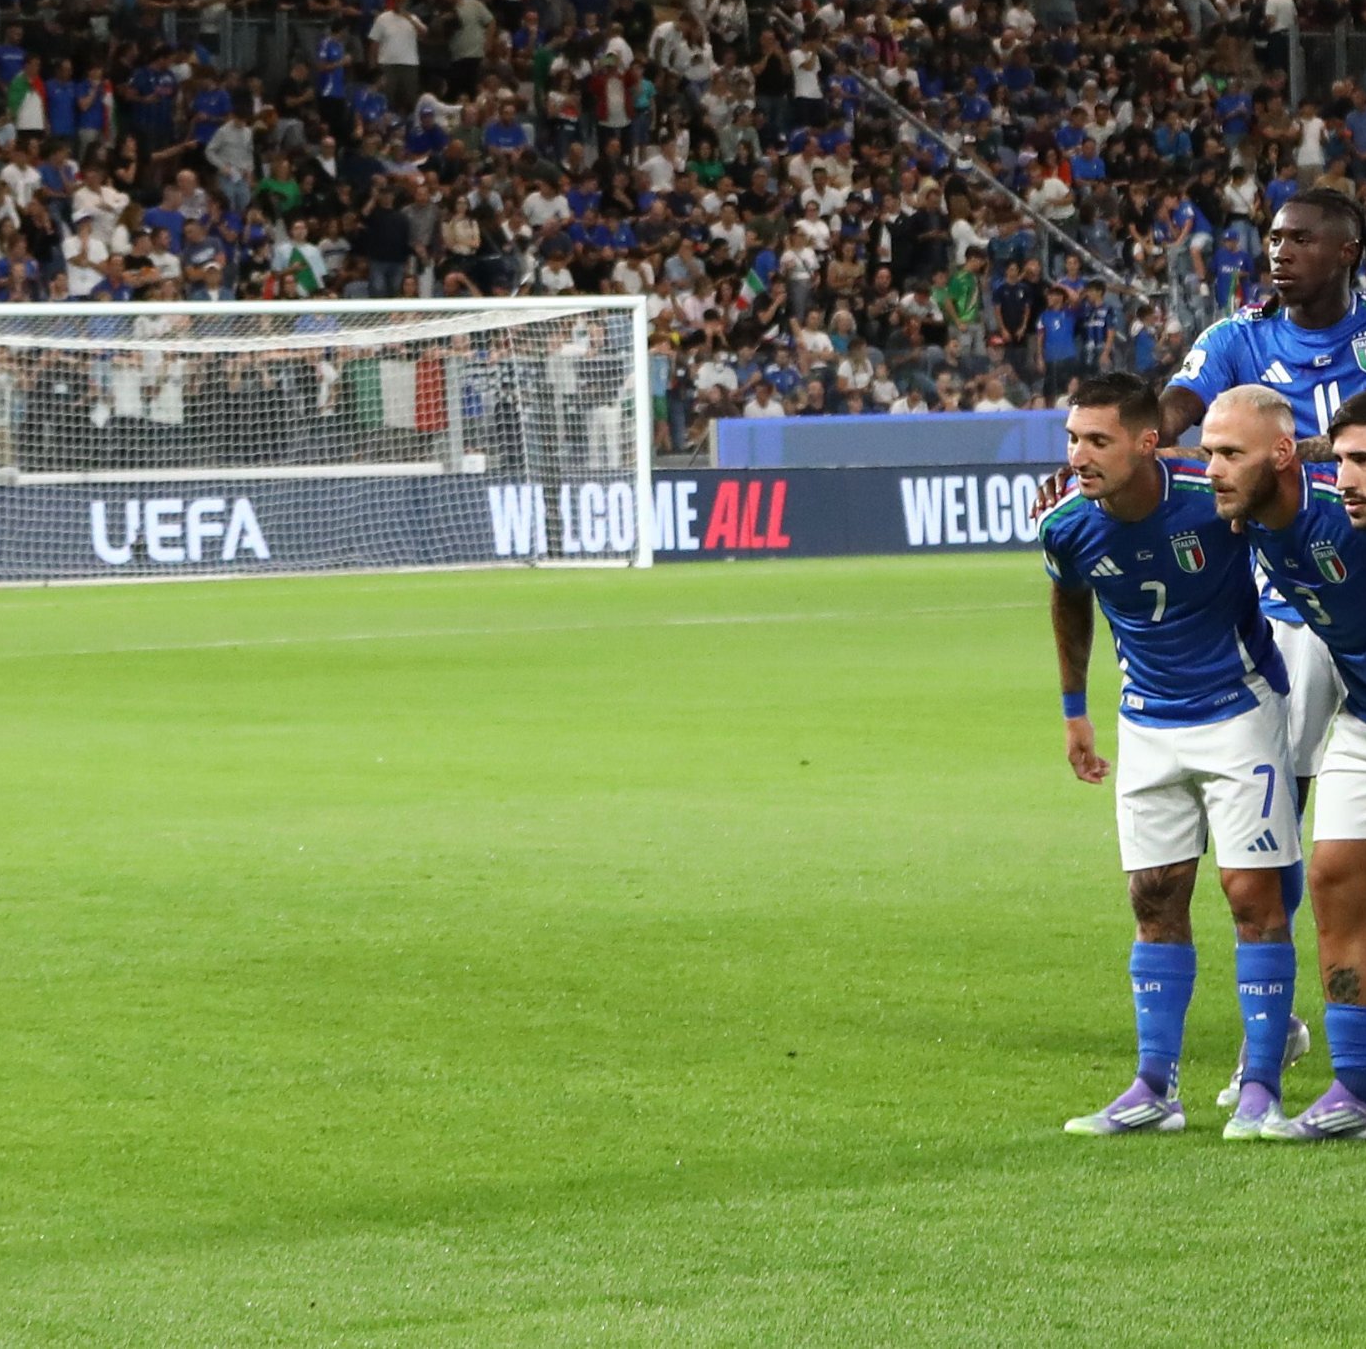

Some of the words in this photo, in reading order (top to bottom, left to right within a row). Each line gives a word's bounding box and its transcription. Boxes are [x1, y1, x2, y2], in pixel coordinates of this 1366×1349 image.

[90, 497, 271, 565] UEFA
[704, 480, 791, 551] ALL
[900, 473, 1051, 546] WELCO
[1140, 580, 1166, 623] 7
[1294, 586, 1333, 626] 3
[1253, 763, 1275, 819] 7
